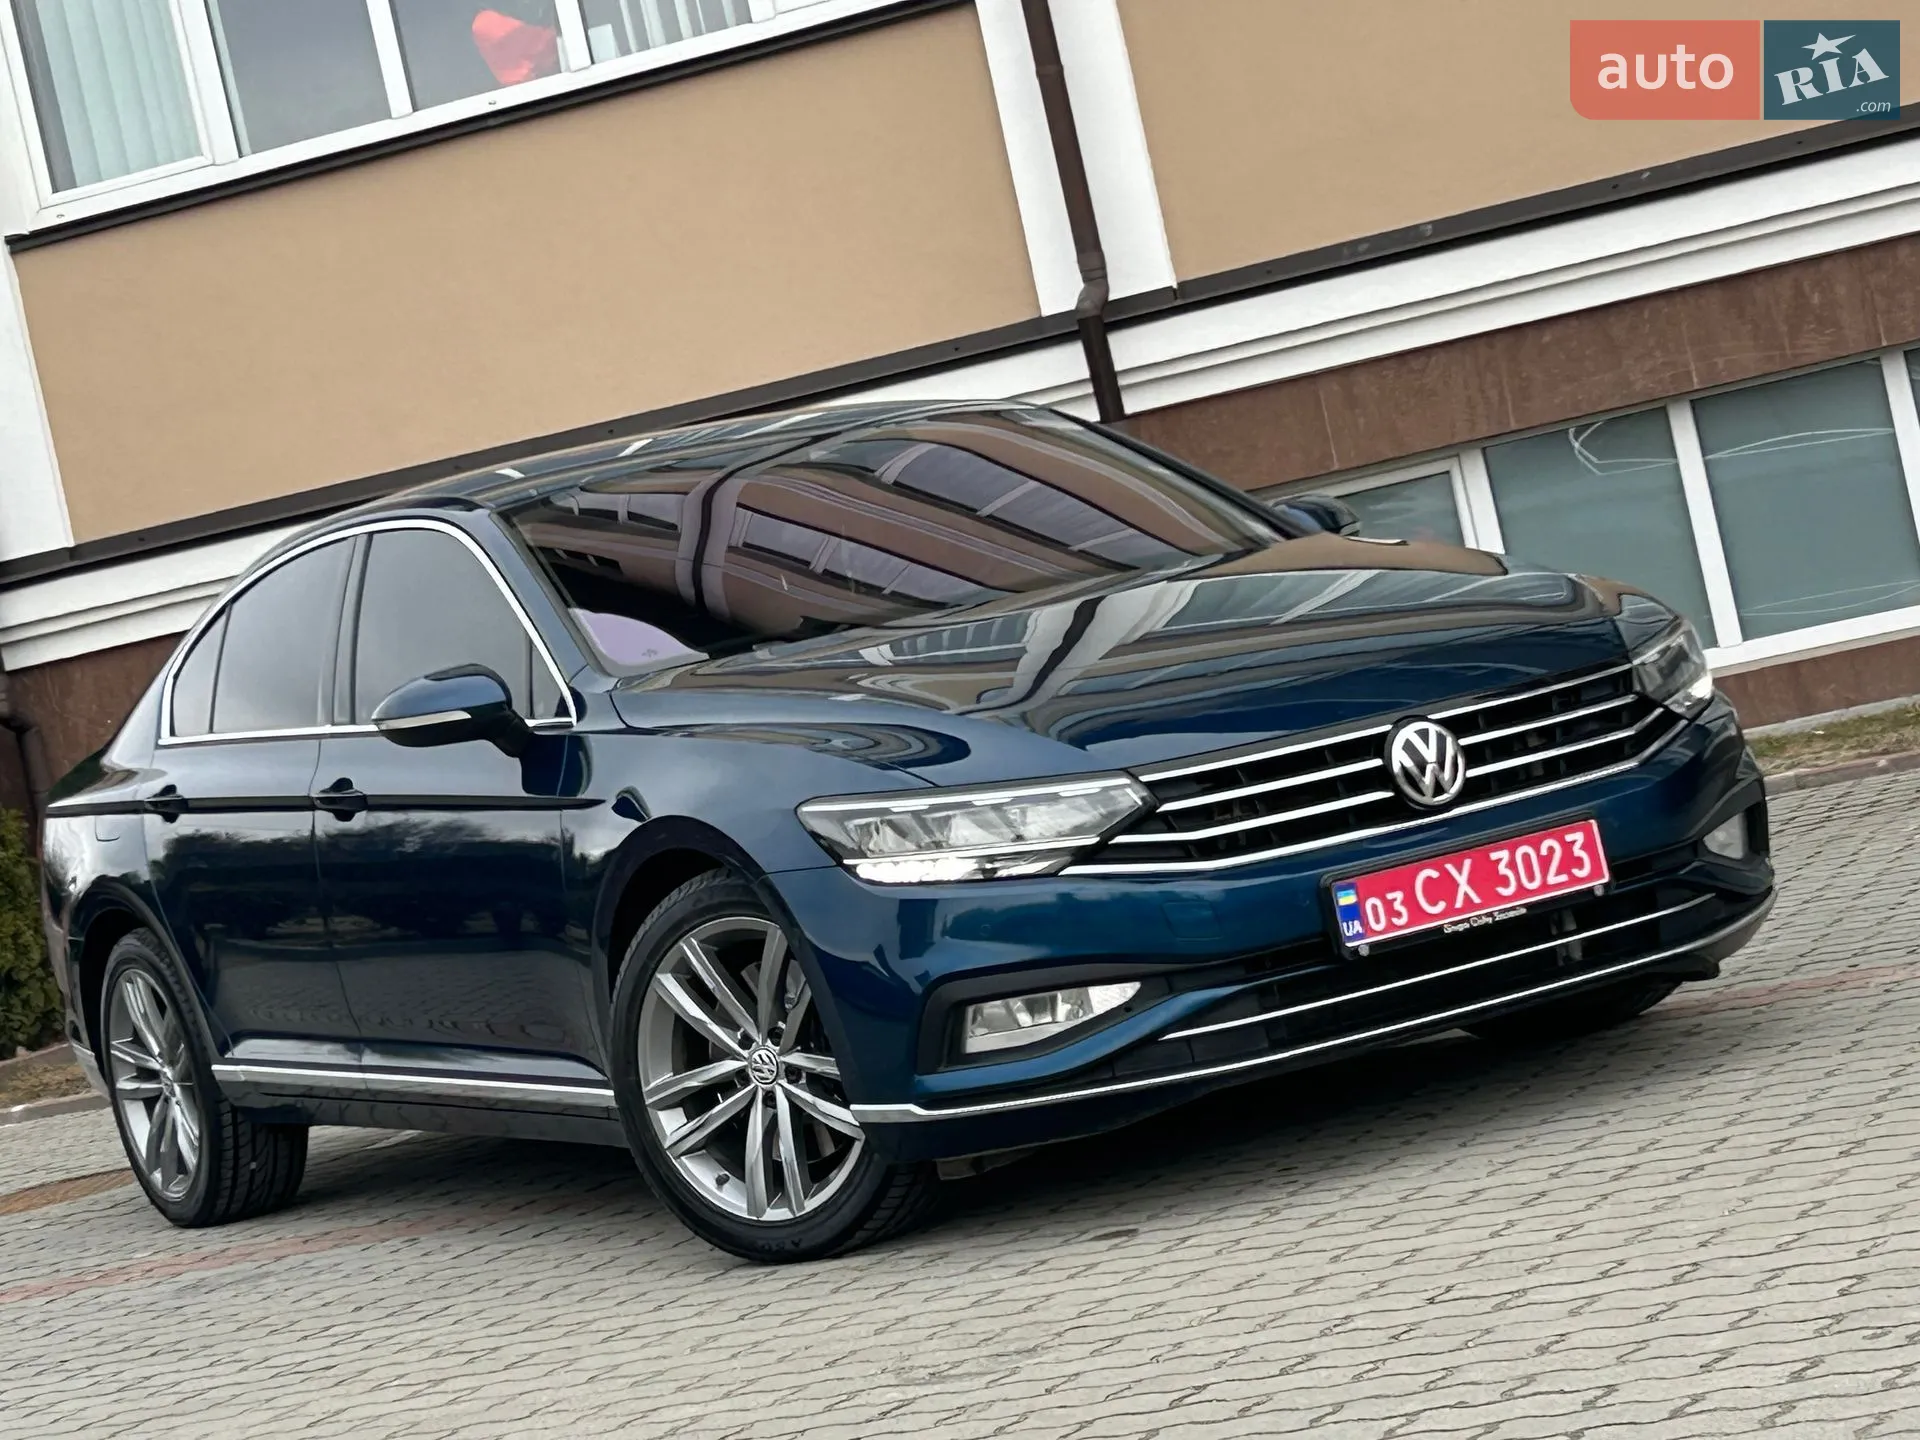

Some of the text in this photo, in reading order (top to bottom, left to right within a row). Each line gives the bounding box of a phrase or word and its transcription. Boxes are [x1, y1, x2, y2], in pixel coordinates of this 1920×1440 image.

[1365, 891, 1408, 931] 03
[1414, 858, 1482, 915] CX
[1489, 831, 1592, 897] 3023
[1342, 919, 1363, 937] UA
